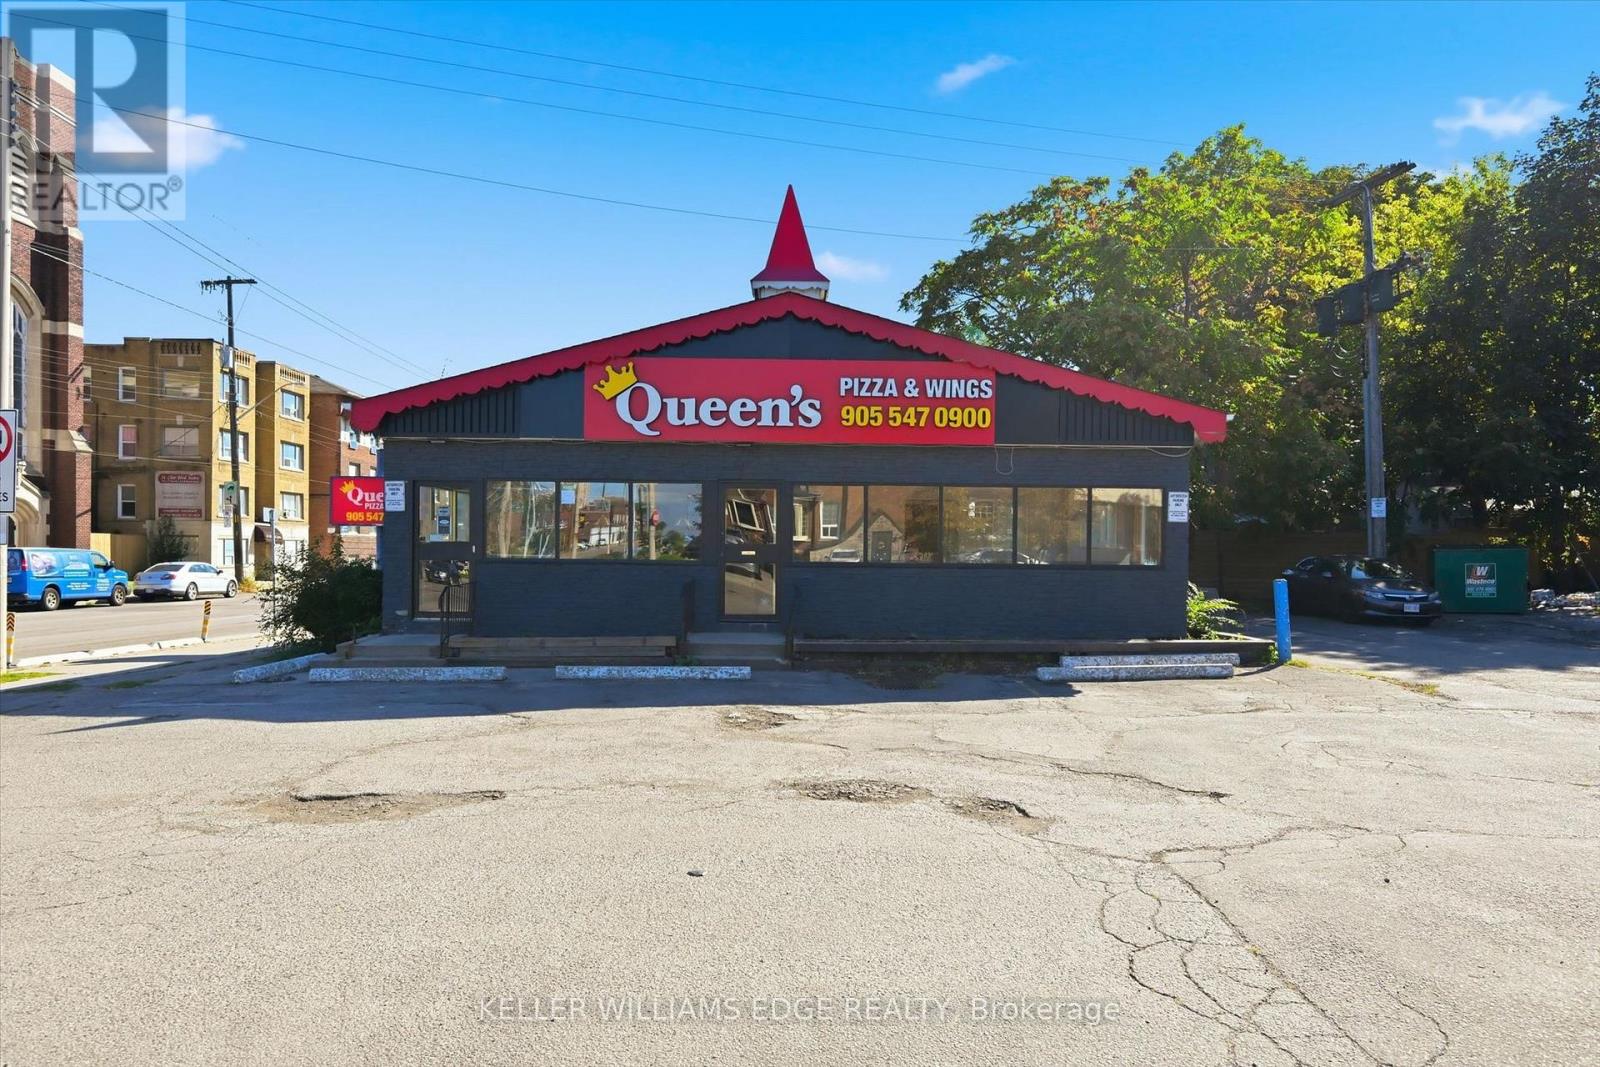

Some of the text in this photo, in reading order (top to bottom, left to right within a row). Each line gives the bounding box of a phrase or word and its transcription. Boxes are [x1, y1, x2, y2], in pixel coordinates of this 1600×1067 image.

[840, 377, 993, 398] PIZZA & WINGS
[615, 381, 822, 436] Queen's
[841, 405, 992, 428] 905 547 0900
[345, 511, 384, 521] 905 547
[364, 502, 384, 510] PIZZA
